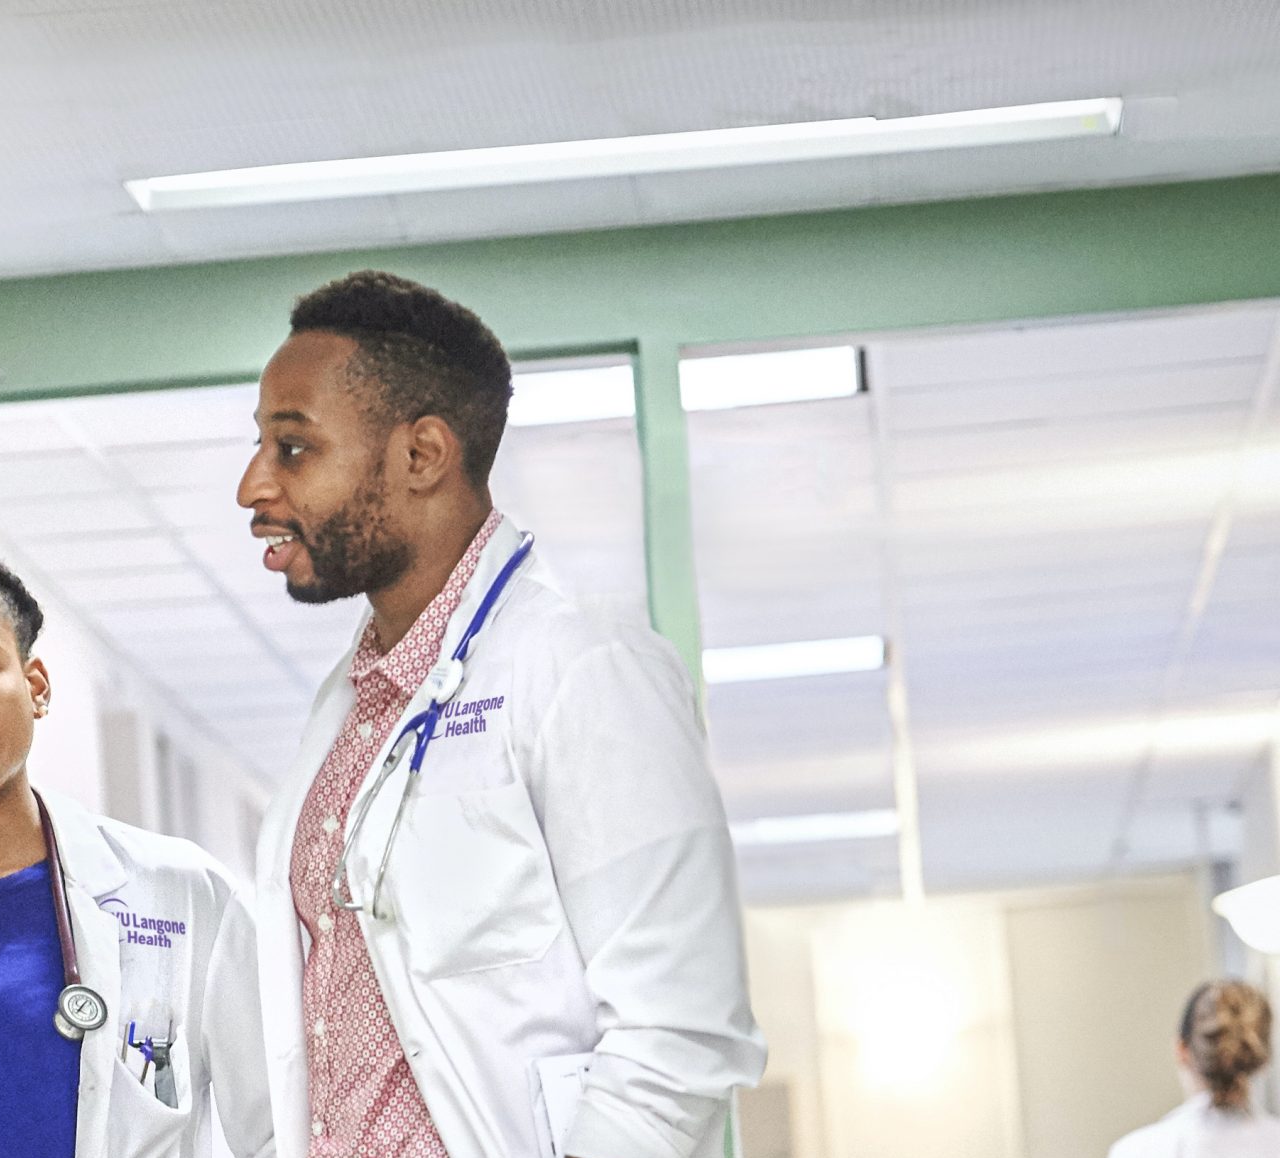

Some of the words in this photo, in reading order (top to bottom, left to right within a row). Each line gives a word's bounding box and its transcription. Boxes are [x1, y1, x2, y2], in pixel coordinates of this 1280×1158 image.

[454, 695, 505, 717] Langone
[444, 715, 486, 738] Health
[132, 912, 186, 935] Langone
[127, 930, 172, 949] Health
